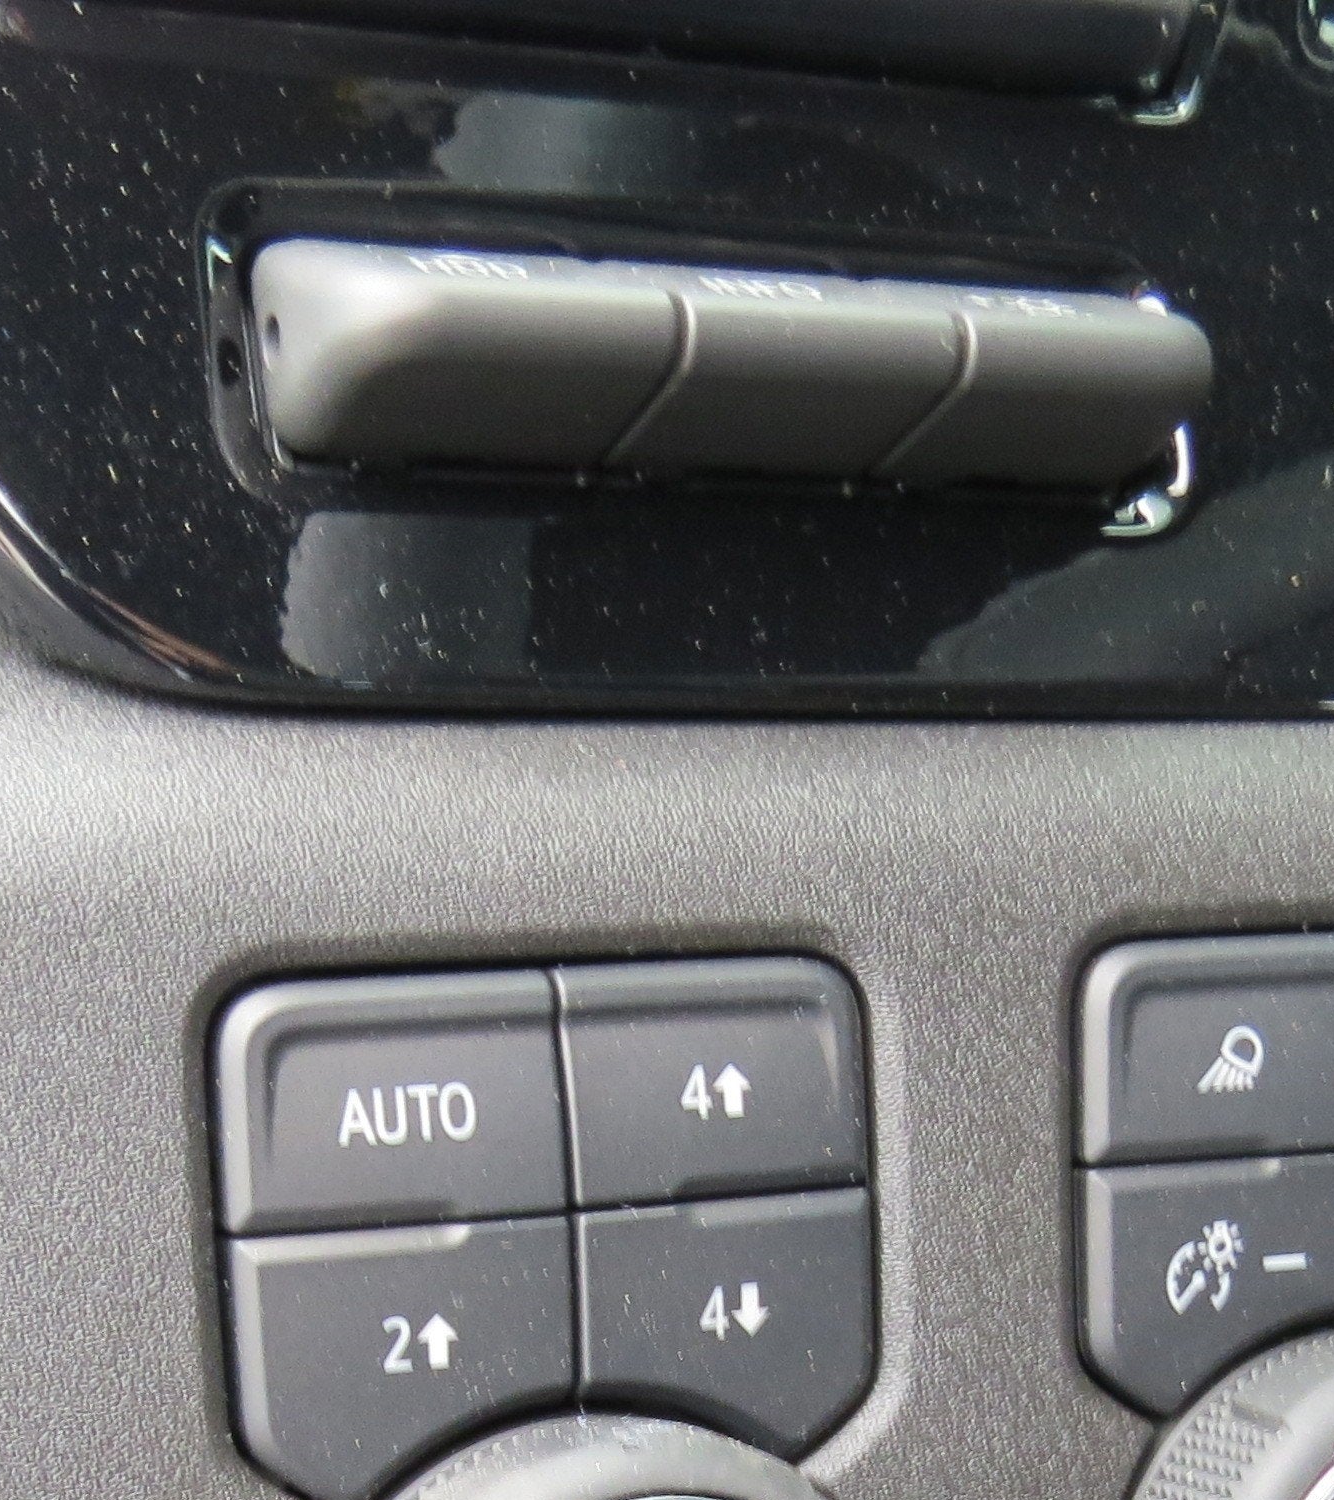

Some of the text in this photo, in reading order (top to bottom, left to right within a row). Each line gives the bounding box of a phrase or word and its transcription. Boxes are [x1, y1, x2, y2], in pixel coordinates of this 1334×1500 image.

[338, 1081, 478, 1149] AUTO
[680, 1063, 714, 1121] 4
[699, 1285, 731, 1341] 4
[382, 1313, 414, 1375] 2
